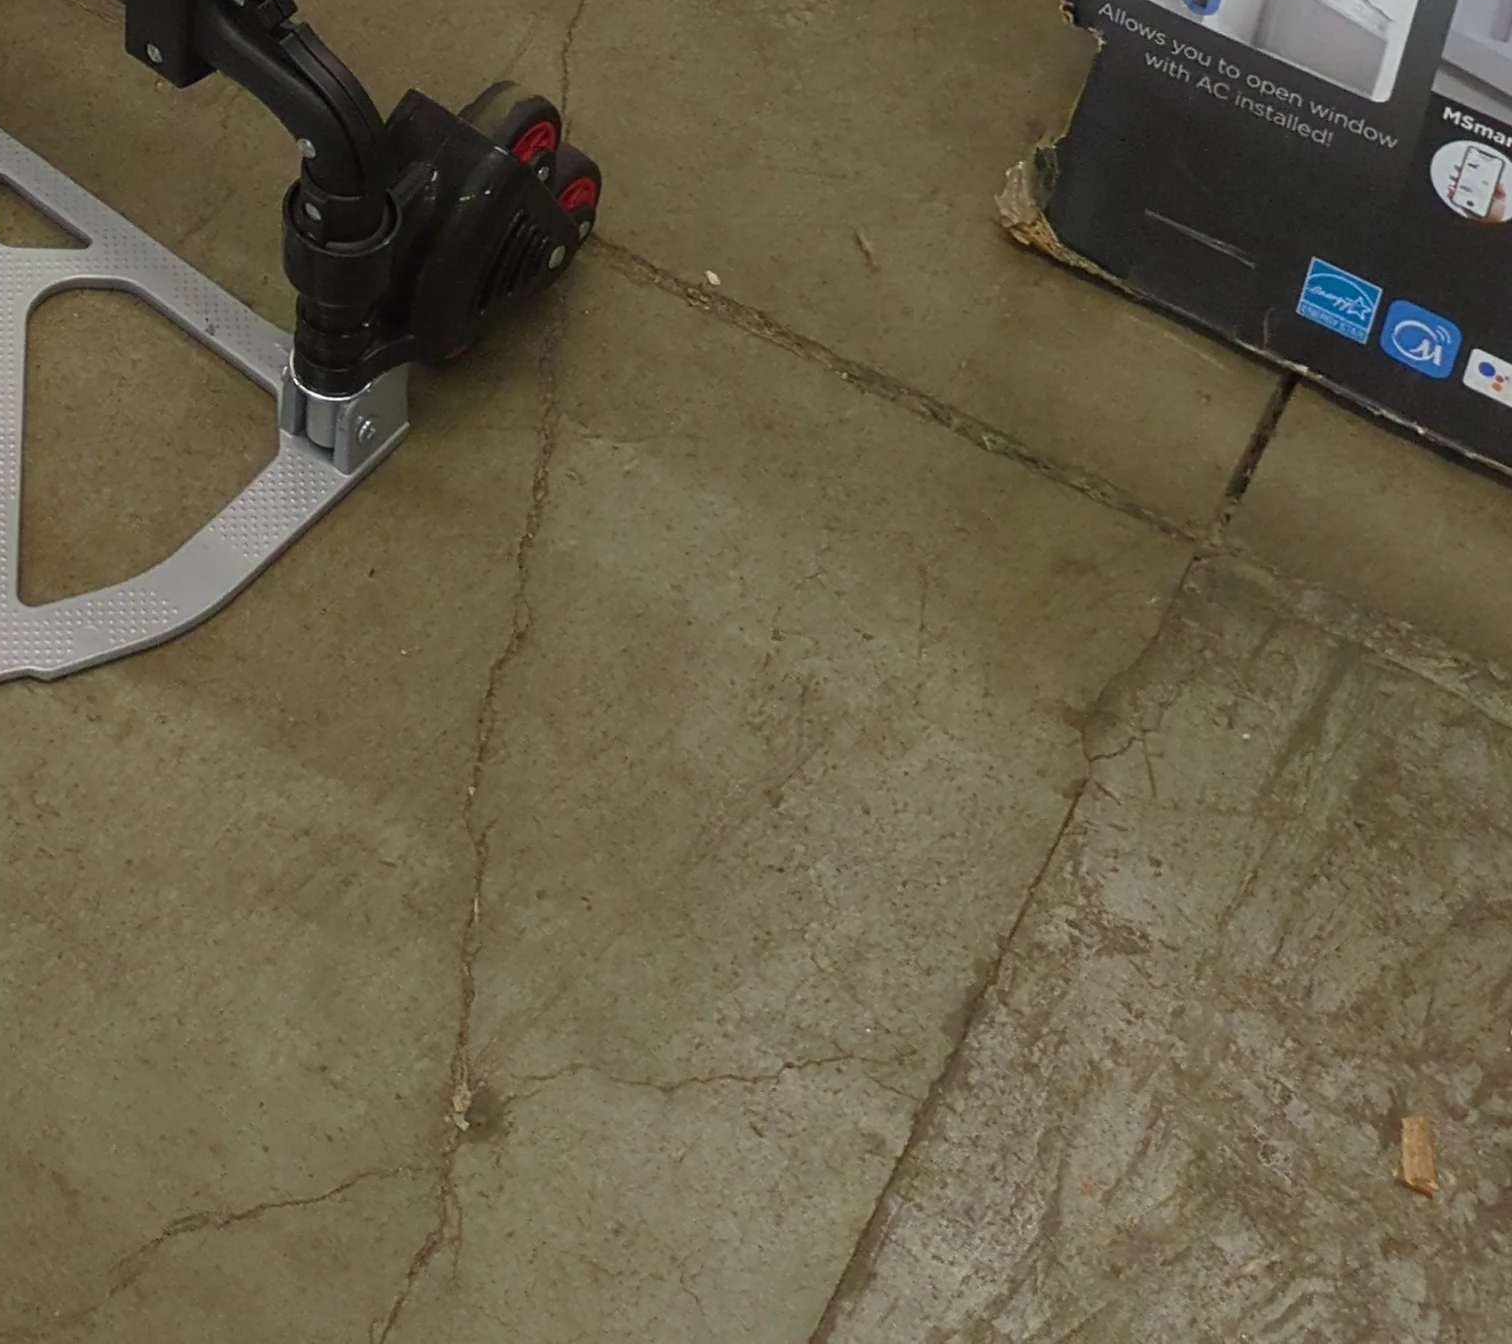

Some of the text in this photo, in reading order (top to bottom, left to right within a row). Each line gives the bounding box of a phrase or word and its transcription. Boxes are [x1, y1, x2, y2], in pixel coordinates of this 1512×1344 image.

[1098, 3, 1398, 150] Allows you to open window
[1144, 52, 1335, 147] with AC installed!
